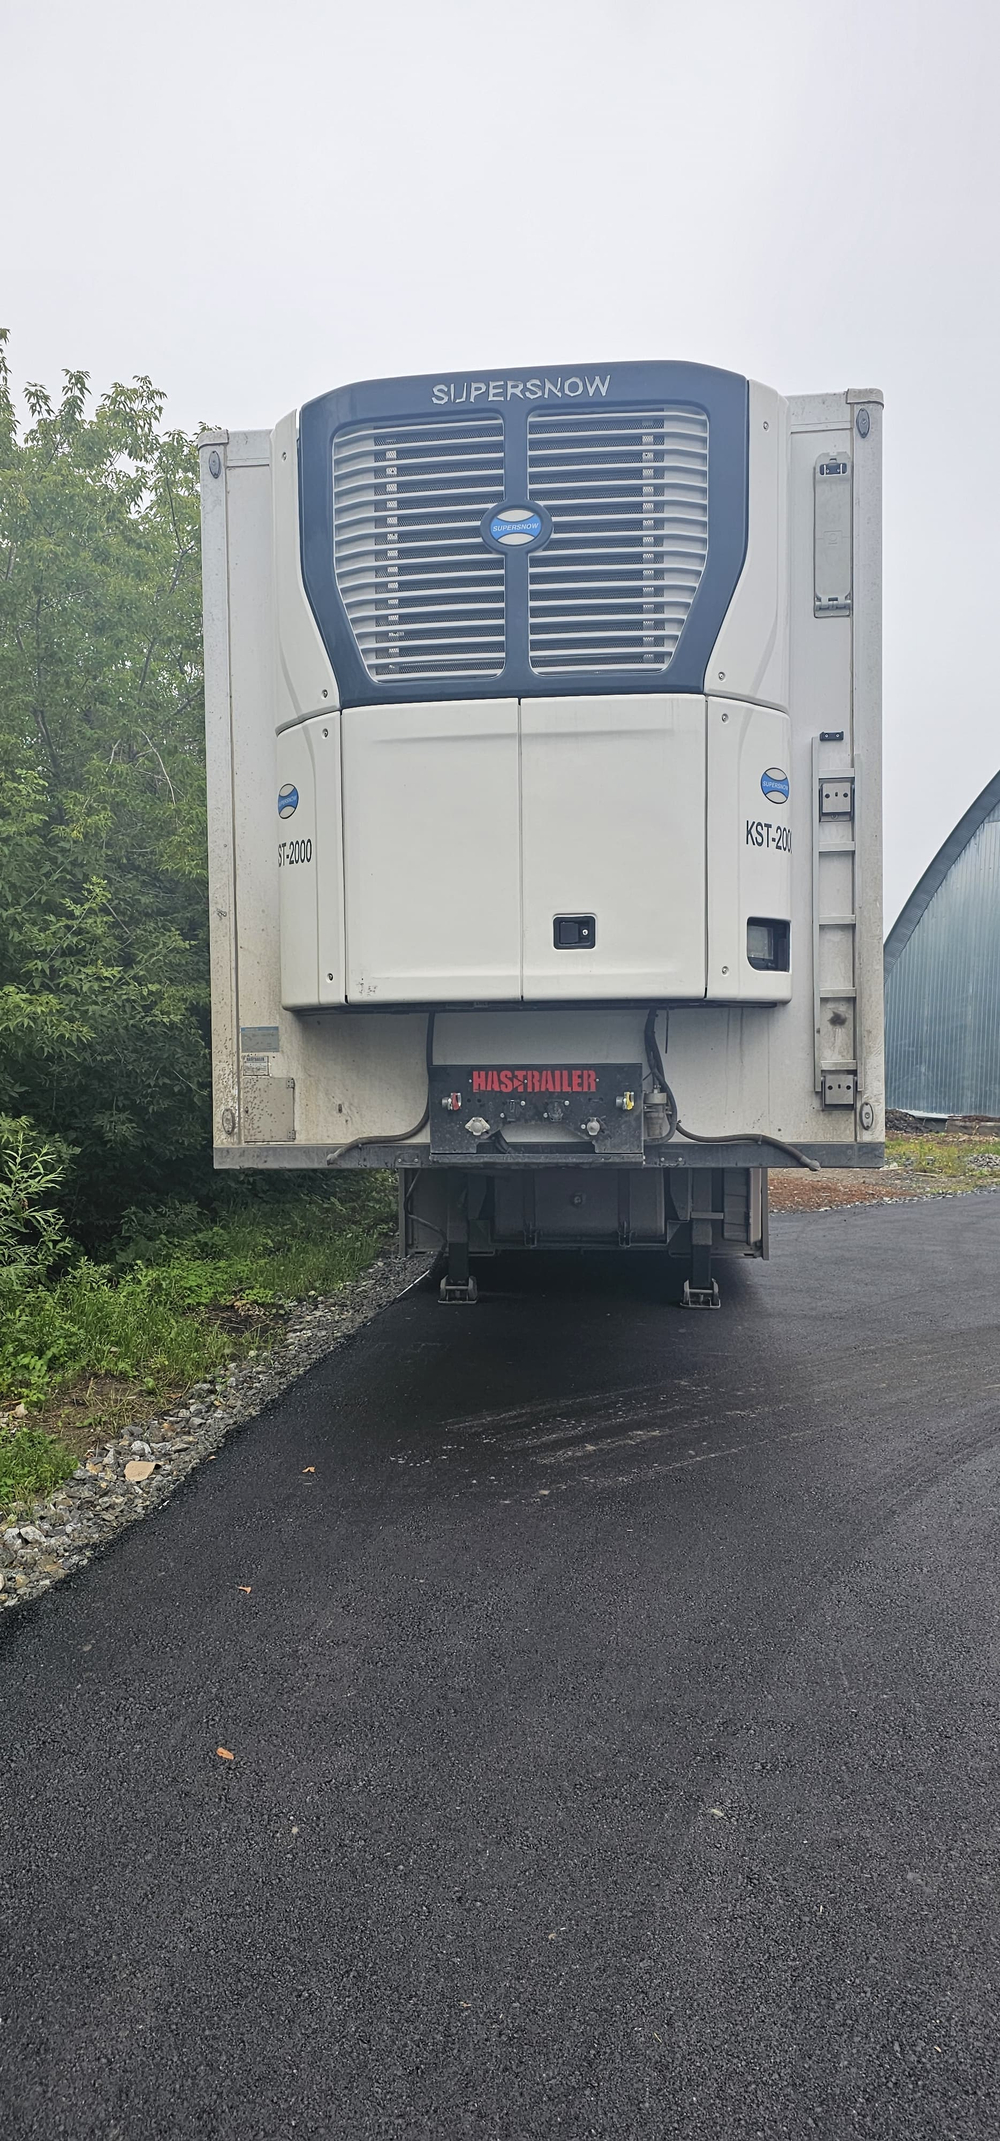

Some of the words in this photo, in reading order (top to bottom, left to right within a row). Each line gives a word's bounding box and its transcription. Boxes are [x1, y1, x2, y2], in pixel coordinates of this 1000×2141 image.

[431, 374, 611, 405] SUPERSNOW
[492, 522, 539, 532] SUPERSNOW
[472, 1070, 596, 1092] HASTRAILER
